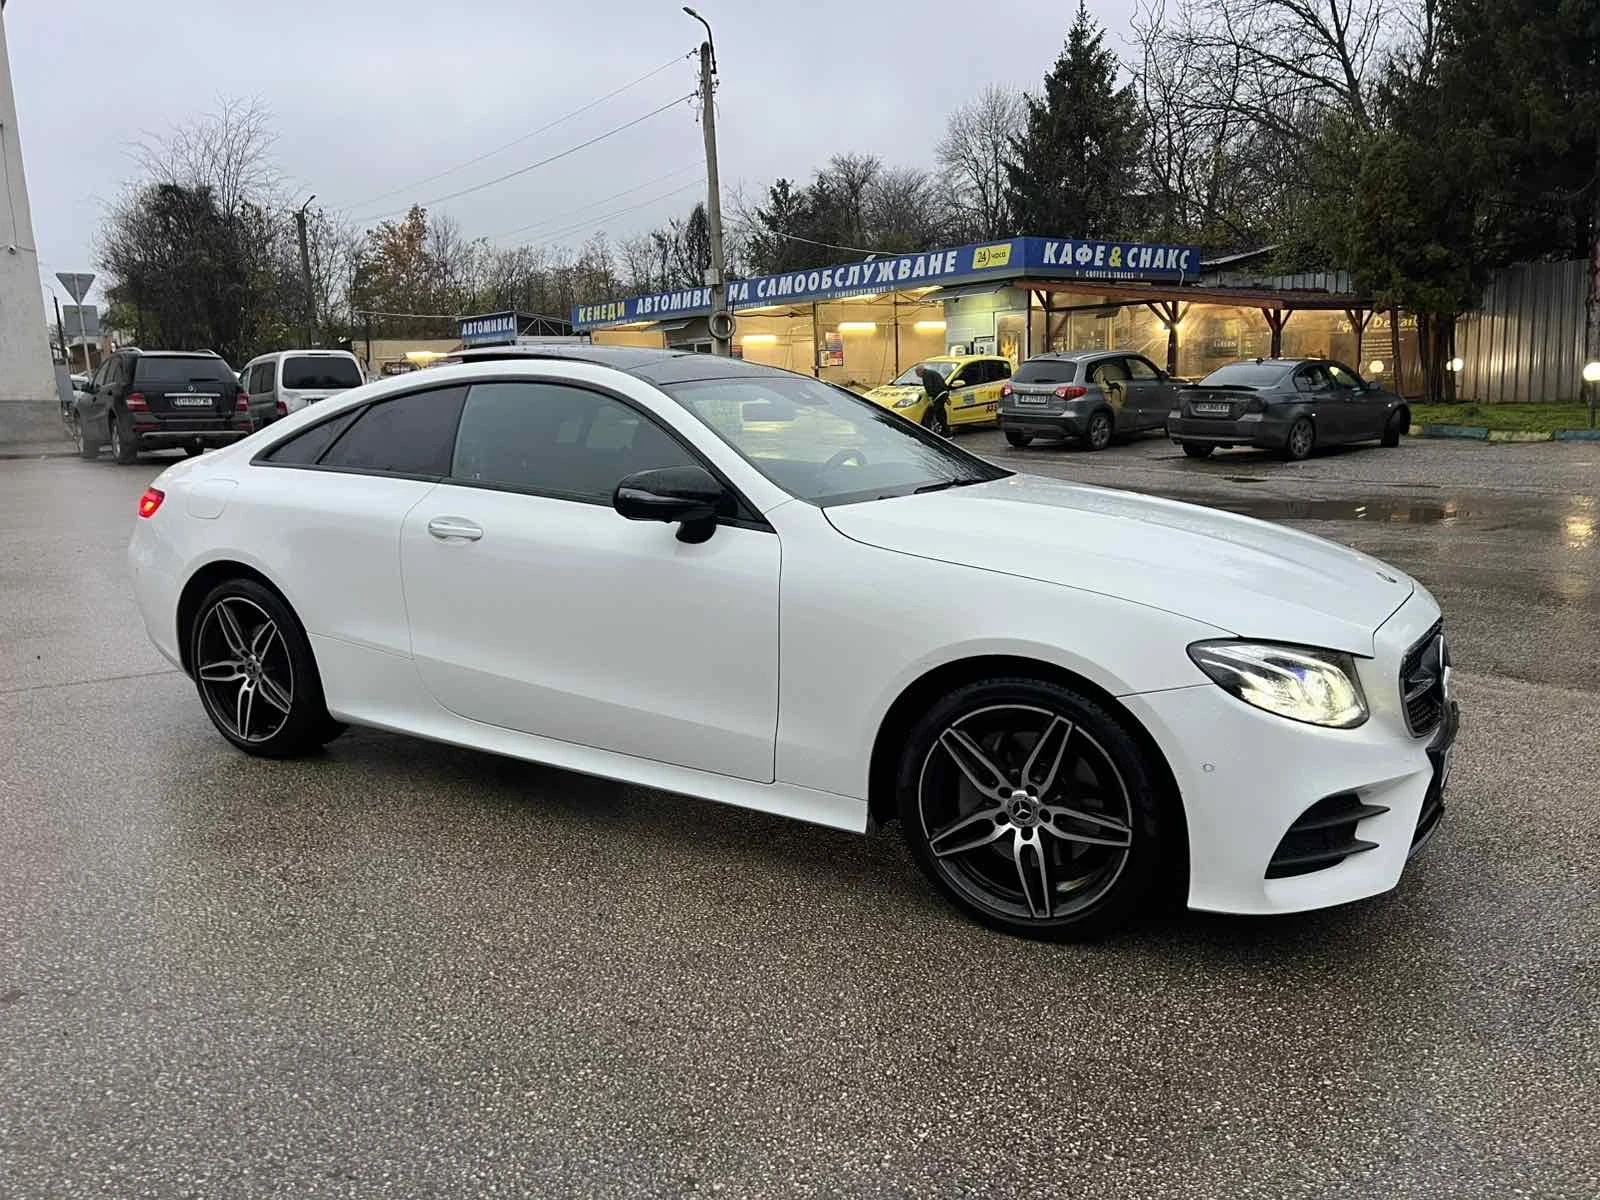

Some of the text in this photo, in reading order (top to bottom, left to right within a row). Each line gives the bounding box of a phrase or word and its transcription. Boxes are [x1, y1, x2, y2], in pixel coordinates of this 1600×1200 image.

[1043, 242, 1191, 269] КАФЕ & СНАКС
[578, 301, 626, 322] КЕНЕДИ
[636, 287, 712, 315] АВТОМИВК
[728, 282, 749, 302] НА
[757, 250, 958, 298] САМООБСЛУЖВАНЕ
[462, 317, 514, 336] АВТОМИВКА
